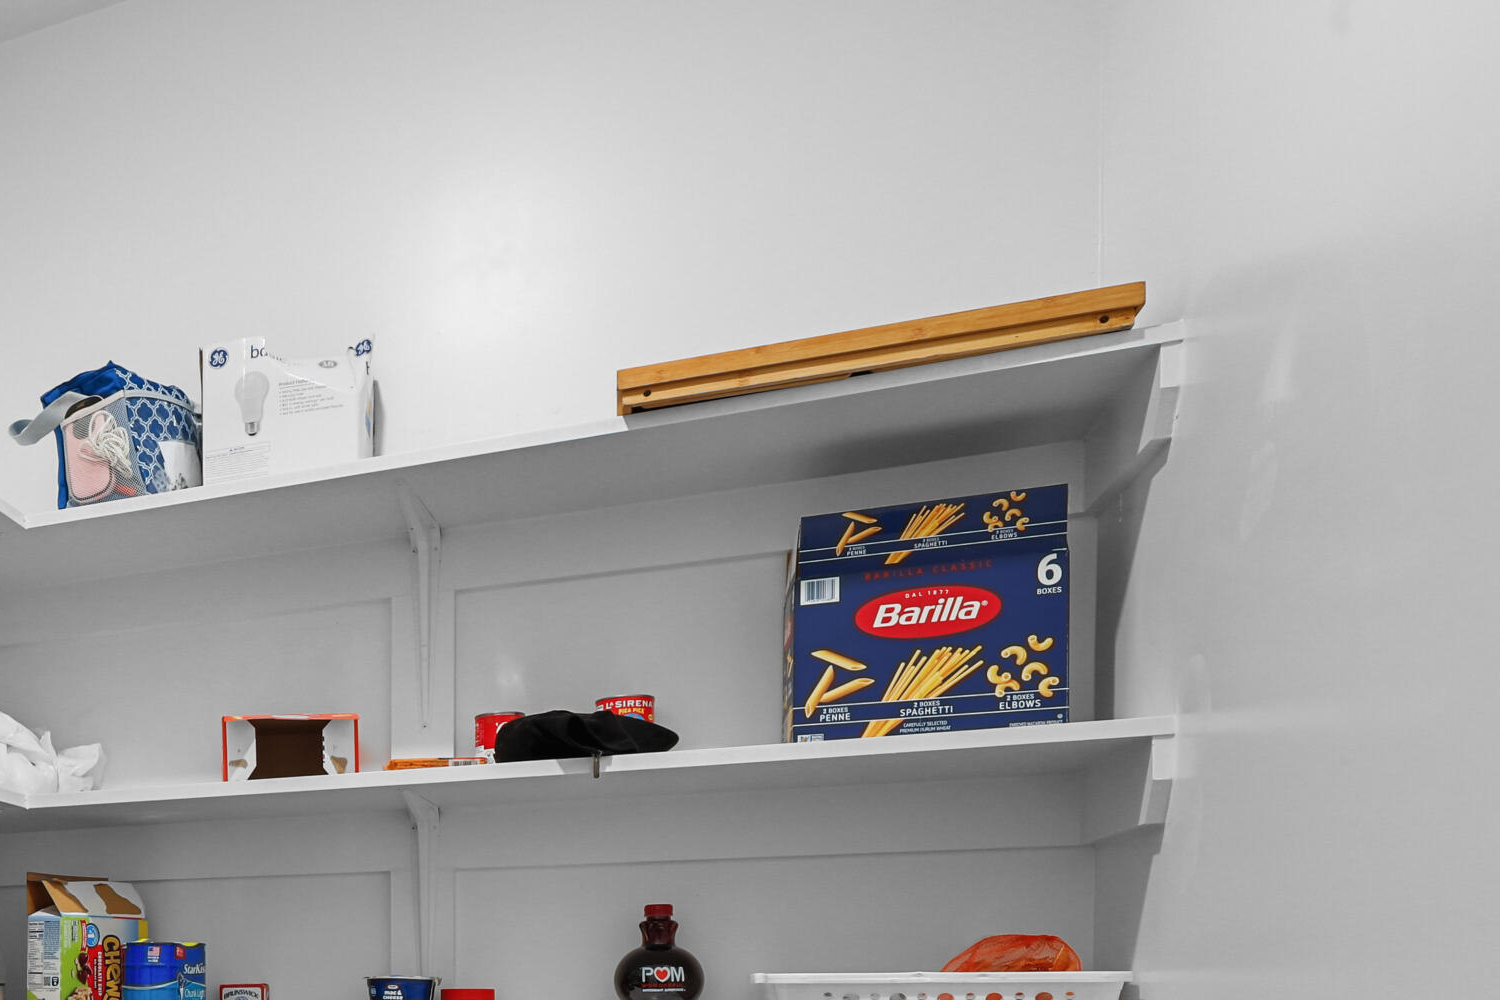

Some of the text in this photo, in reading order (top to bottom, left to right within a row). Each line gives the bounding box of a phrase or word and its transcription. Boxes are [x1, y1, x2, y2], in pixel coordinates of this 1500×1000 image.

[991, 531, 1018, 540] ELBOWS
[913, 540, 948, 549] SPAGHETTI
[846, 549, 867, 557] PENNE
[864, 560, 993, 581] BARILLA CLASSIC
[1036, 552, 1063, 587] 6
[905, 589, 949, 599] DAL 1877
[1036, 587, 1062, 595] BOXES
[872, 596, 981, 629] Barilla
[1012, 693, 1035, 701] BOXES
[615, 700, 653, 708] SIRENA
[999, 699, 1042, 710] ELBOWS
[819, 712, 851, 722] PENNE
[899, 706, 954, 718] SPAGHETTI
[641, 966, 685, 983] POM
[223, 988, 259, 1000] BRUNSWICK
